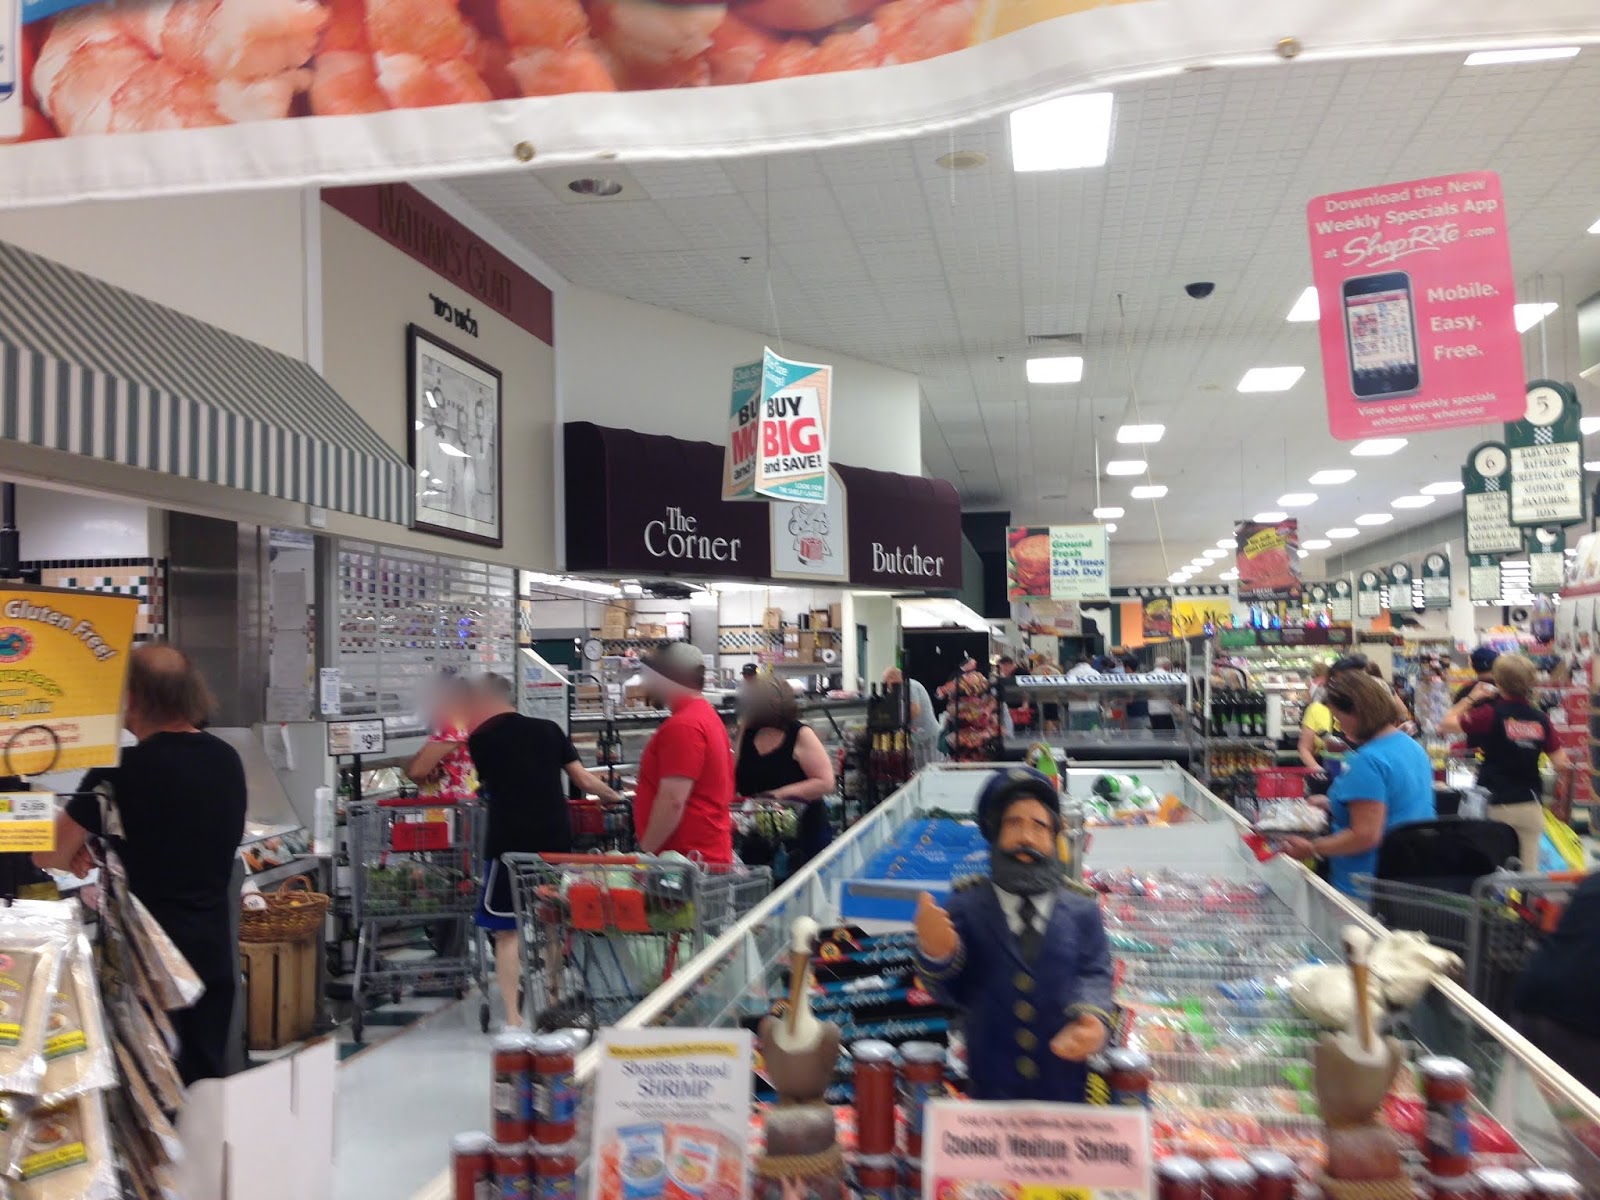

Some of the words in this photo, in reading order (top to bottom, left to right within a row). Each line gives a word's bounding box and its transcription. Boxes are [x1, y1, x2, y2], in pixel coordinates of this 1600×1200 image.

[1325, 188, 1410, 213] Download
[1414, 184, 1443, 199] the
[1447, 180, 1486, 194] New
[1315, 214, 1380, 235] Weekly
[1385, 202, 1459, 224] Specials
[1463, 199, 1498, 214] App
[1324, 248, 1338, 259] at
[1342, 223, 1461, 267] ShopRite
[1427, 282, 1500, 304] Mobile.
[1430, 313, 1482, 334] Easy.
[1433, 343, 1485, 361] Free.
[738, 394, 761, 427] BU
[767, 396, 803, 418] BUY
[1537, 395, 1549, 414] 5
[731, 421, 759, 466] MO
[762, 417, 821, 458] BIG
[764, 458, 780, 473] and
[782, 454, 822, 472] SAVE!
[1486, 455, 1496, 470] 6
[665, 506, 698, 533] The
[643, 520, 742, 563] Corner
[1051, 539, 1093, 549] Ground
[871, 542, 945, 577] Butcher
[1052, 549, 1082, 558] Fresh
[1052, 568, 1079, 576] Each
[1082, 567, 1104, 577] Day
[4, 600, 73, 632] Gluten
[72, 619, 118, 661] Free!
[1075, 673, 1141, 685] KOSHER
[1145, 673, 1185, 683] ONLY
